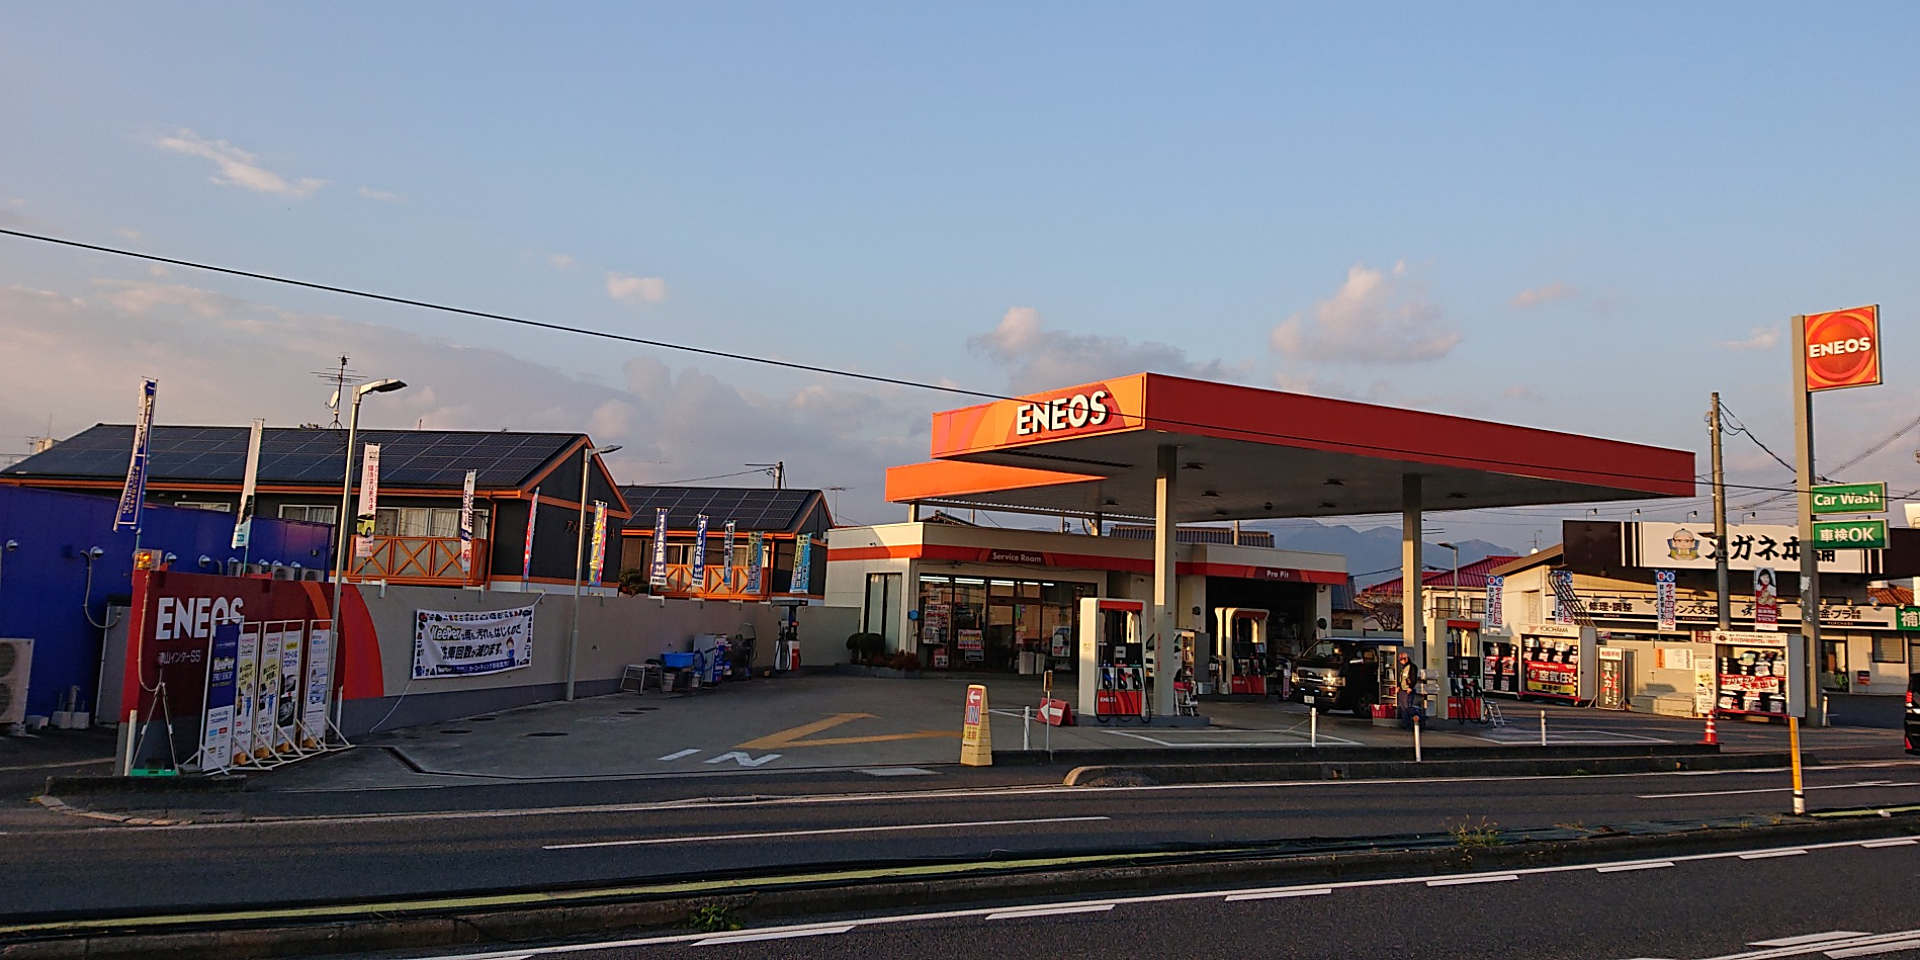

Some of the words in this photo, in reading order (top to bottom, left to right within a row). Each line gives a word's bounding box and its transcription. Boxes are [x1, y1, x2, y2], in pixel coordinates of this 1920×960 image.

[1809, 337, 1871, 358] ENEOS
[1016, 391, 1107, 435] ENEOS
[1814, 494, 1837, 506] Car
[1840, 490, 1879, 505] Wash
[1820, 527, 1875, 542] 車検OK
[992, 552, 1019, 561] Service
[1021, 554, 1041, 562] Room
[156, 597, 244, 640] ENEOS
[657, 749, 782, 767] IN
